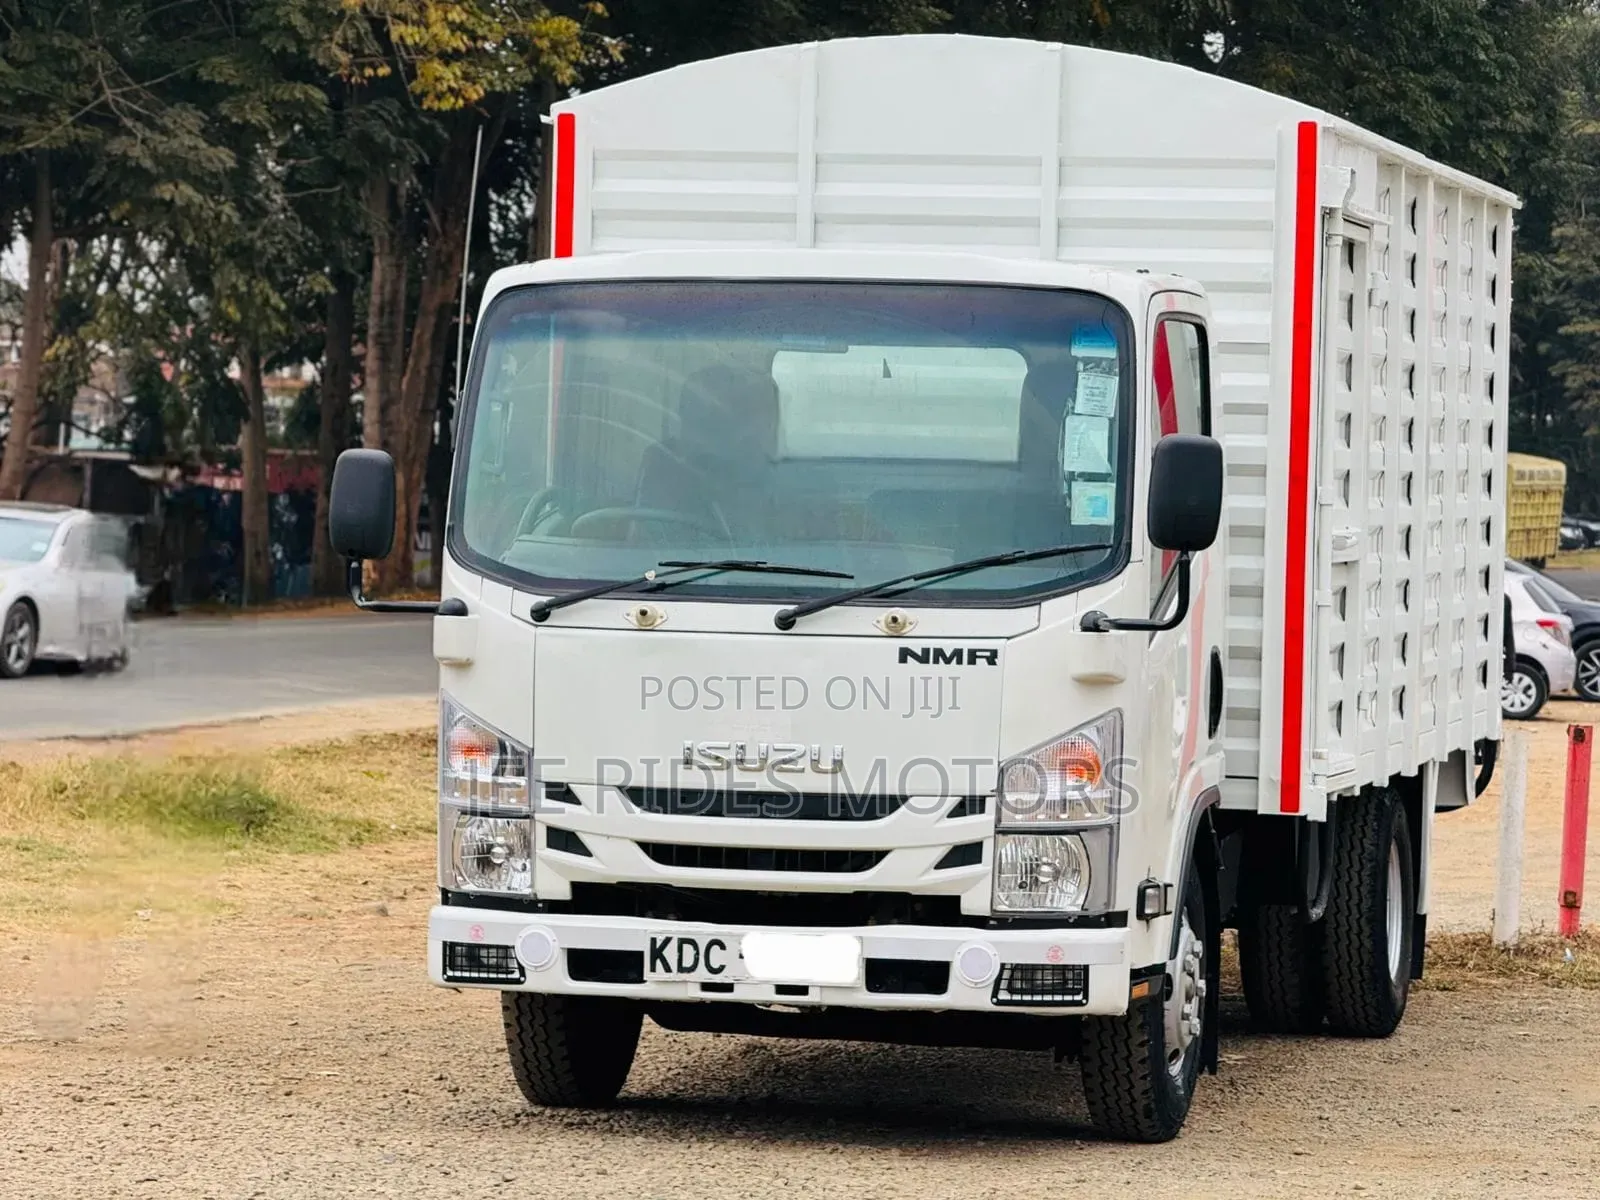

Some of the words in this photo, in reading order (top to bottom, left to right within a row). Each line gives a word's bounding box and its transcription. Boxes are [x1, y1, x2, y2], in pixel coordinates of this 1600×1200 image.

[898, 647, 998, 666] NMR
[683, 740, 844, 774] ISUZU
[650, 936, 727, 975] KDC
